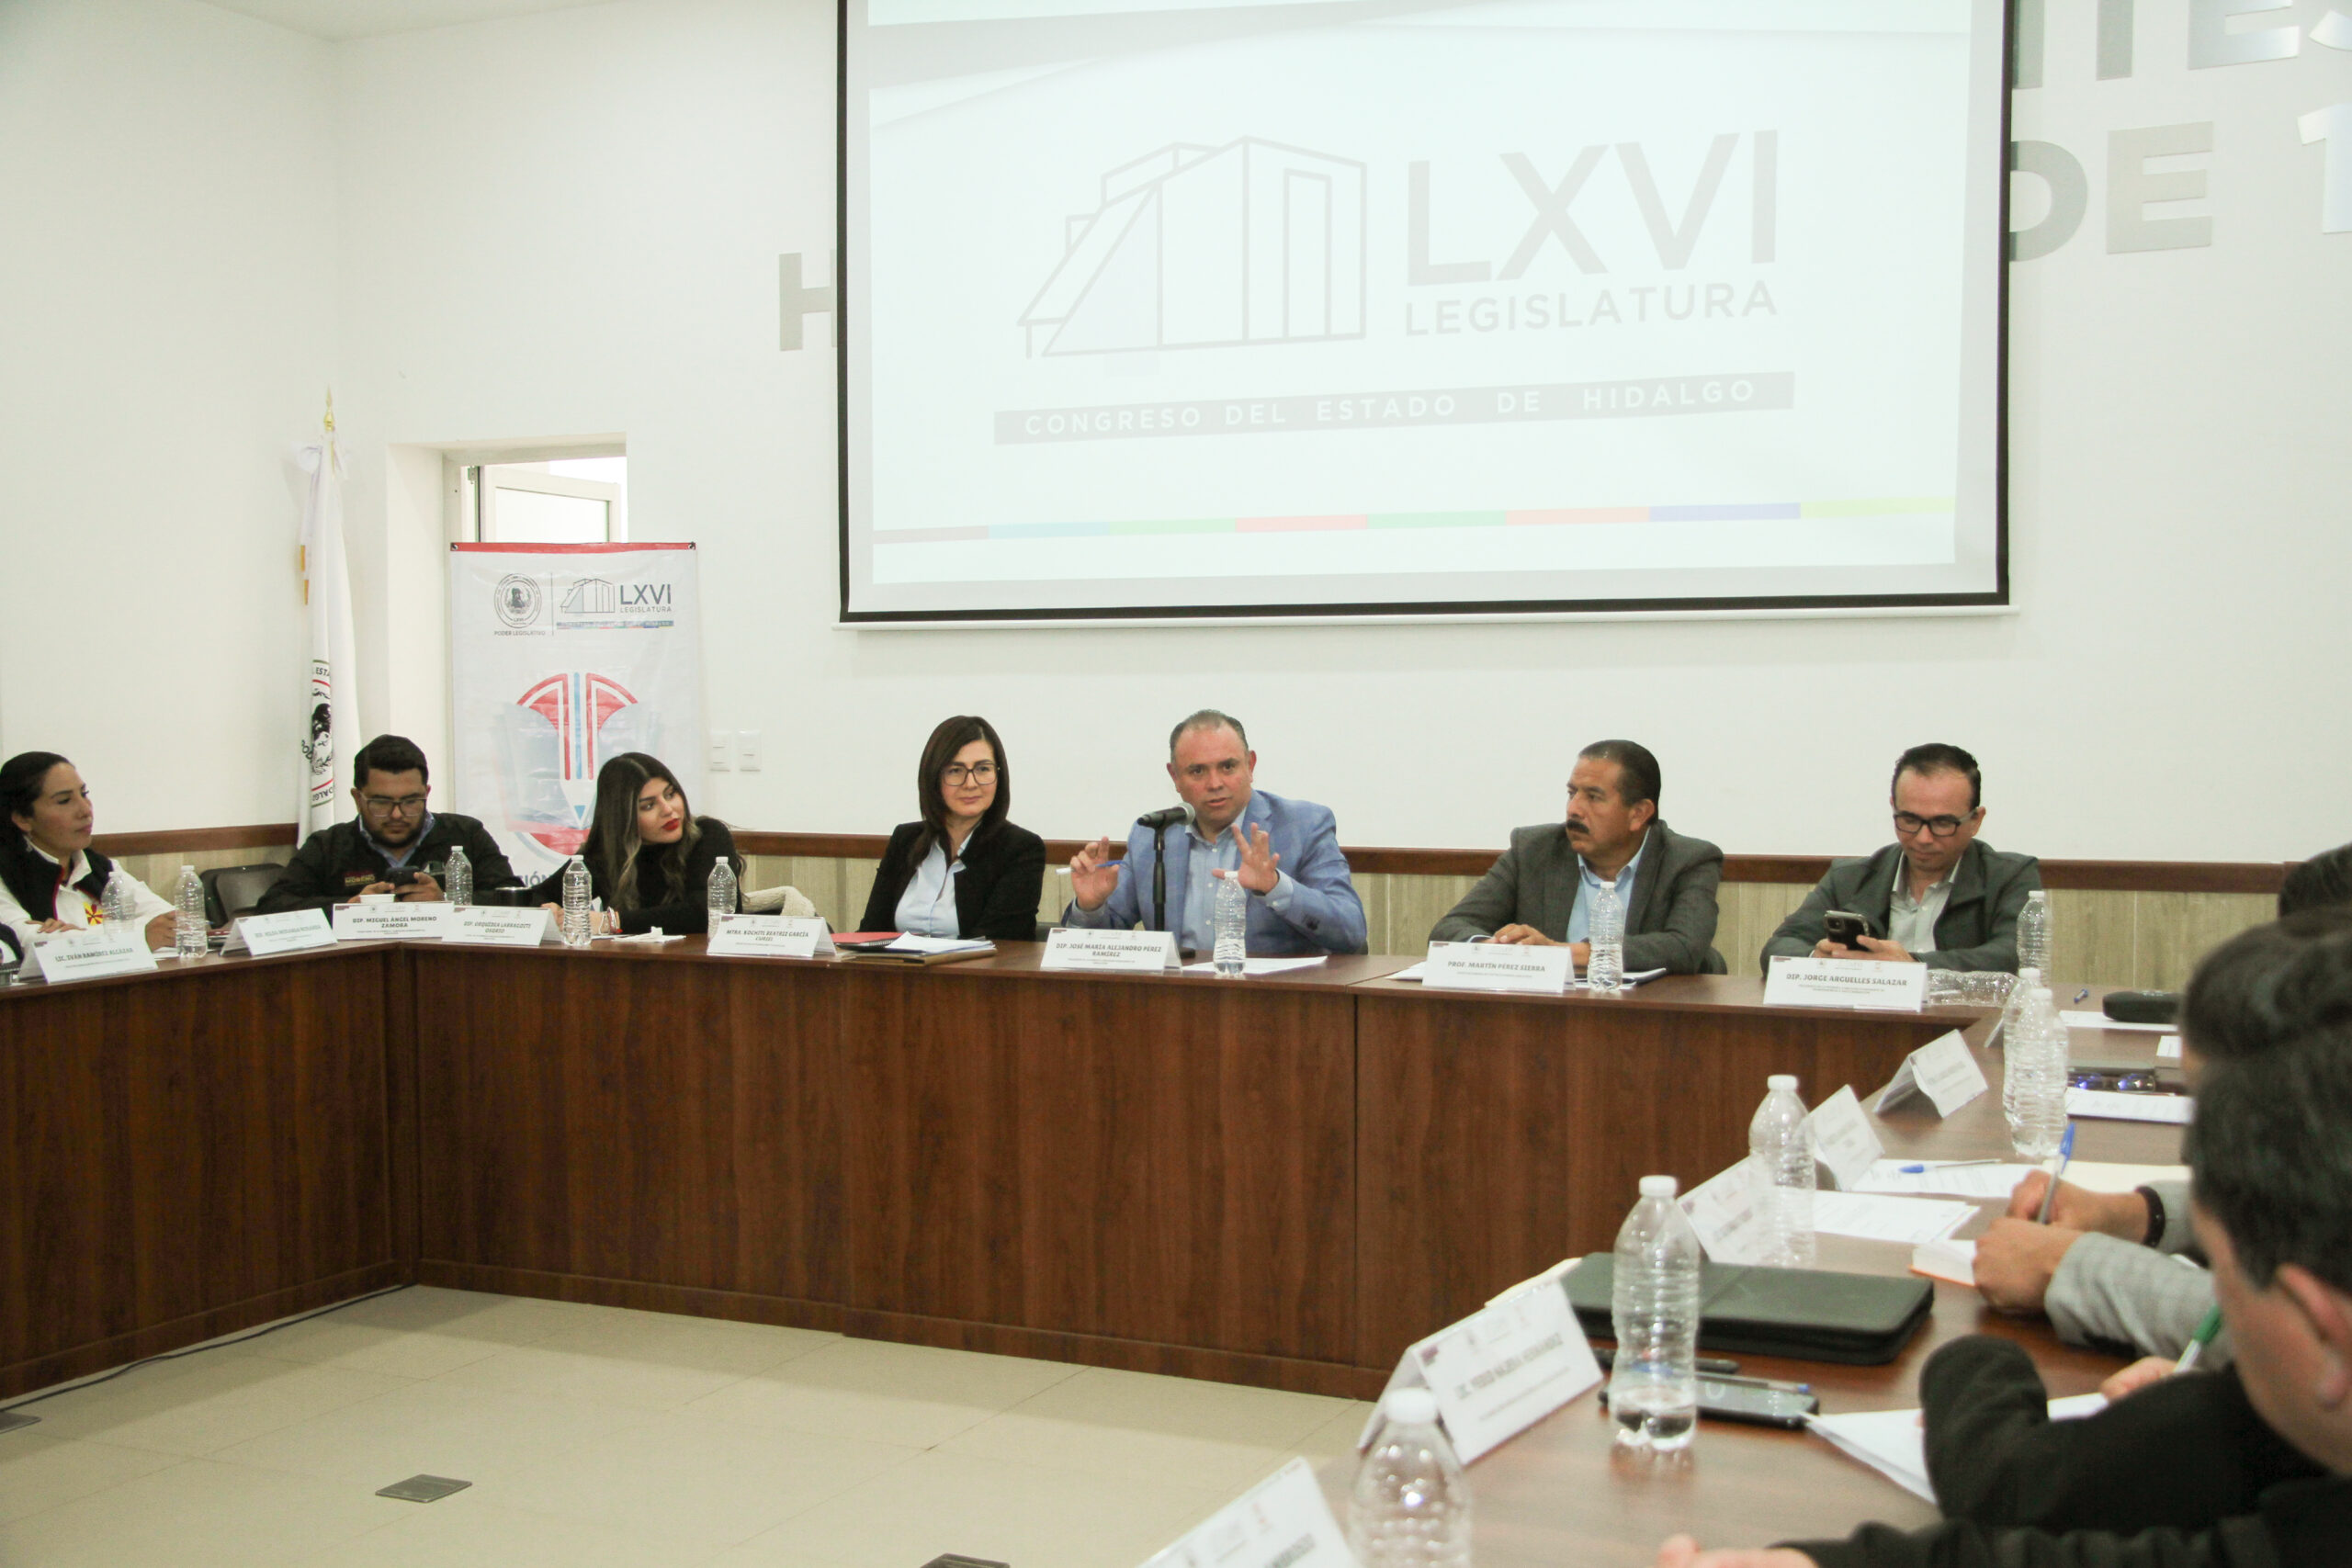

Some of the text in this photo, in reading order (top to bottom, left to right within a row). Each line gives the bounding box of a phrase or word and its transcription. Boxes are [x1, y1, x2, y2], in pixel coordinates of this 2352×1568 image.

[1408, 130, 1778, 286] LXVI
[2009, 121, 2212, 262] DE
[1406, 280, 1778, 336] LEGISLATURA
[1025, 379, 1755, 434] CONGRESO DEL ESTADO DE HIDALGO
[620, 584, 672, 604] LXVI
